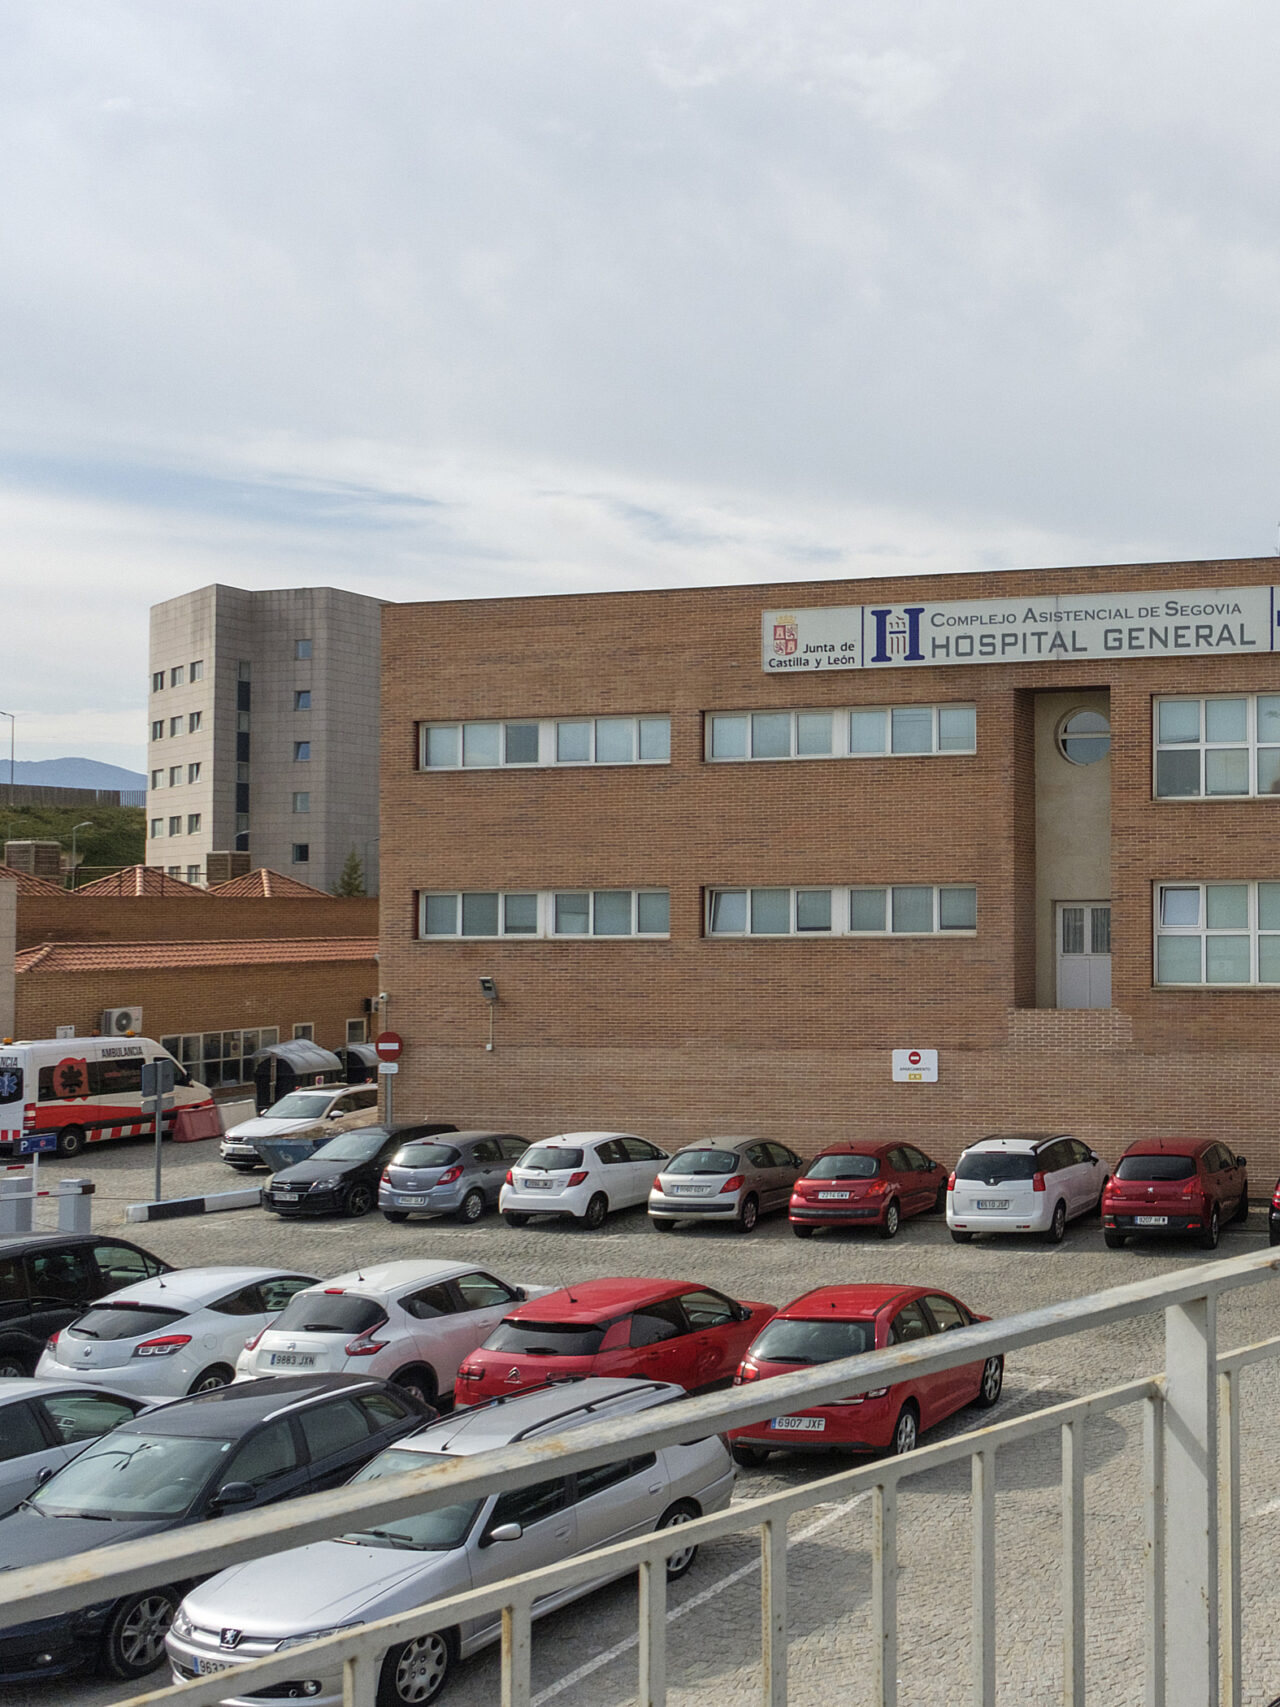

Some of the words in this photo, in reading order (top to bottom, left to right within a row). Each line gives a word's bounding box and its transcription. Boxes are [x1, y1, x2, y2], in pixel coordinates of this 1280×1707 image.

[1138, 606, 1160, 618] DE
[930, 630, 1088, 659] HOSPITAL
[1103, 623, 1257, 651] GENERAL
[802, 642, 836, 654] Junta
[840, 641, 855, 652] de
[768, 655, 810, 668] Castilla
[814, 657, 822, 669] y
[827, 654, 856, 666] León
[101, 1046, 144, 1058] AMBULANCIA
[20, 1140, 29, 1152] P
[276, 1354, 297, 1365] 9883
[298, 1355, 315, 1366] JXN
[778, 1417, 803, 1429] 6907
[805, 1419, 824, 1430] JXF
